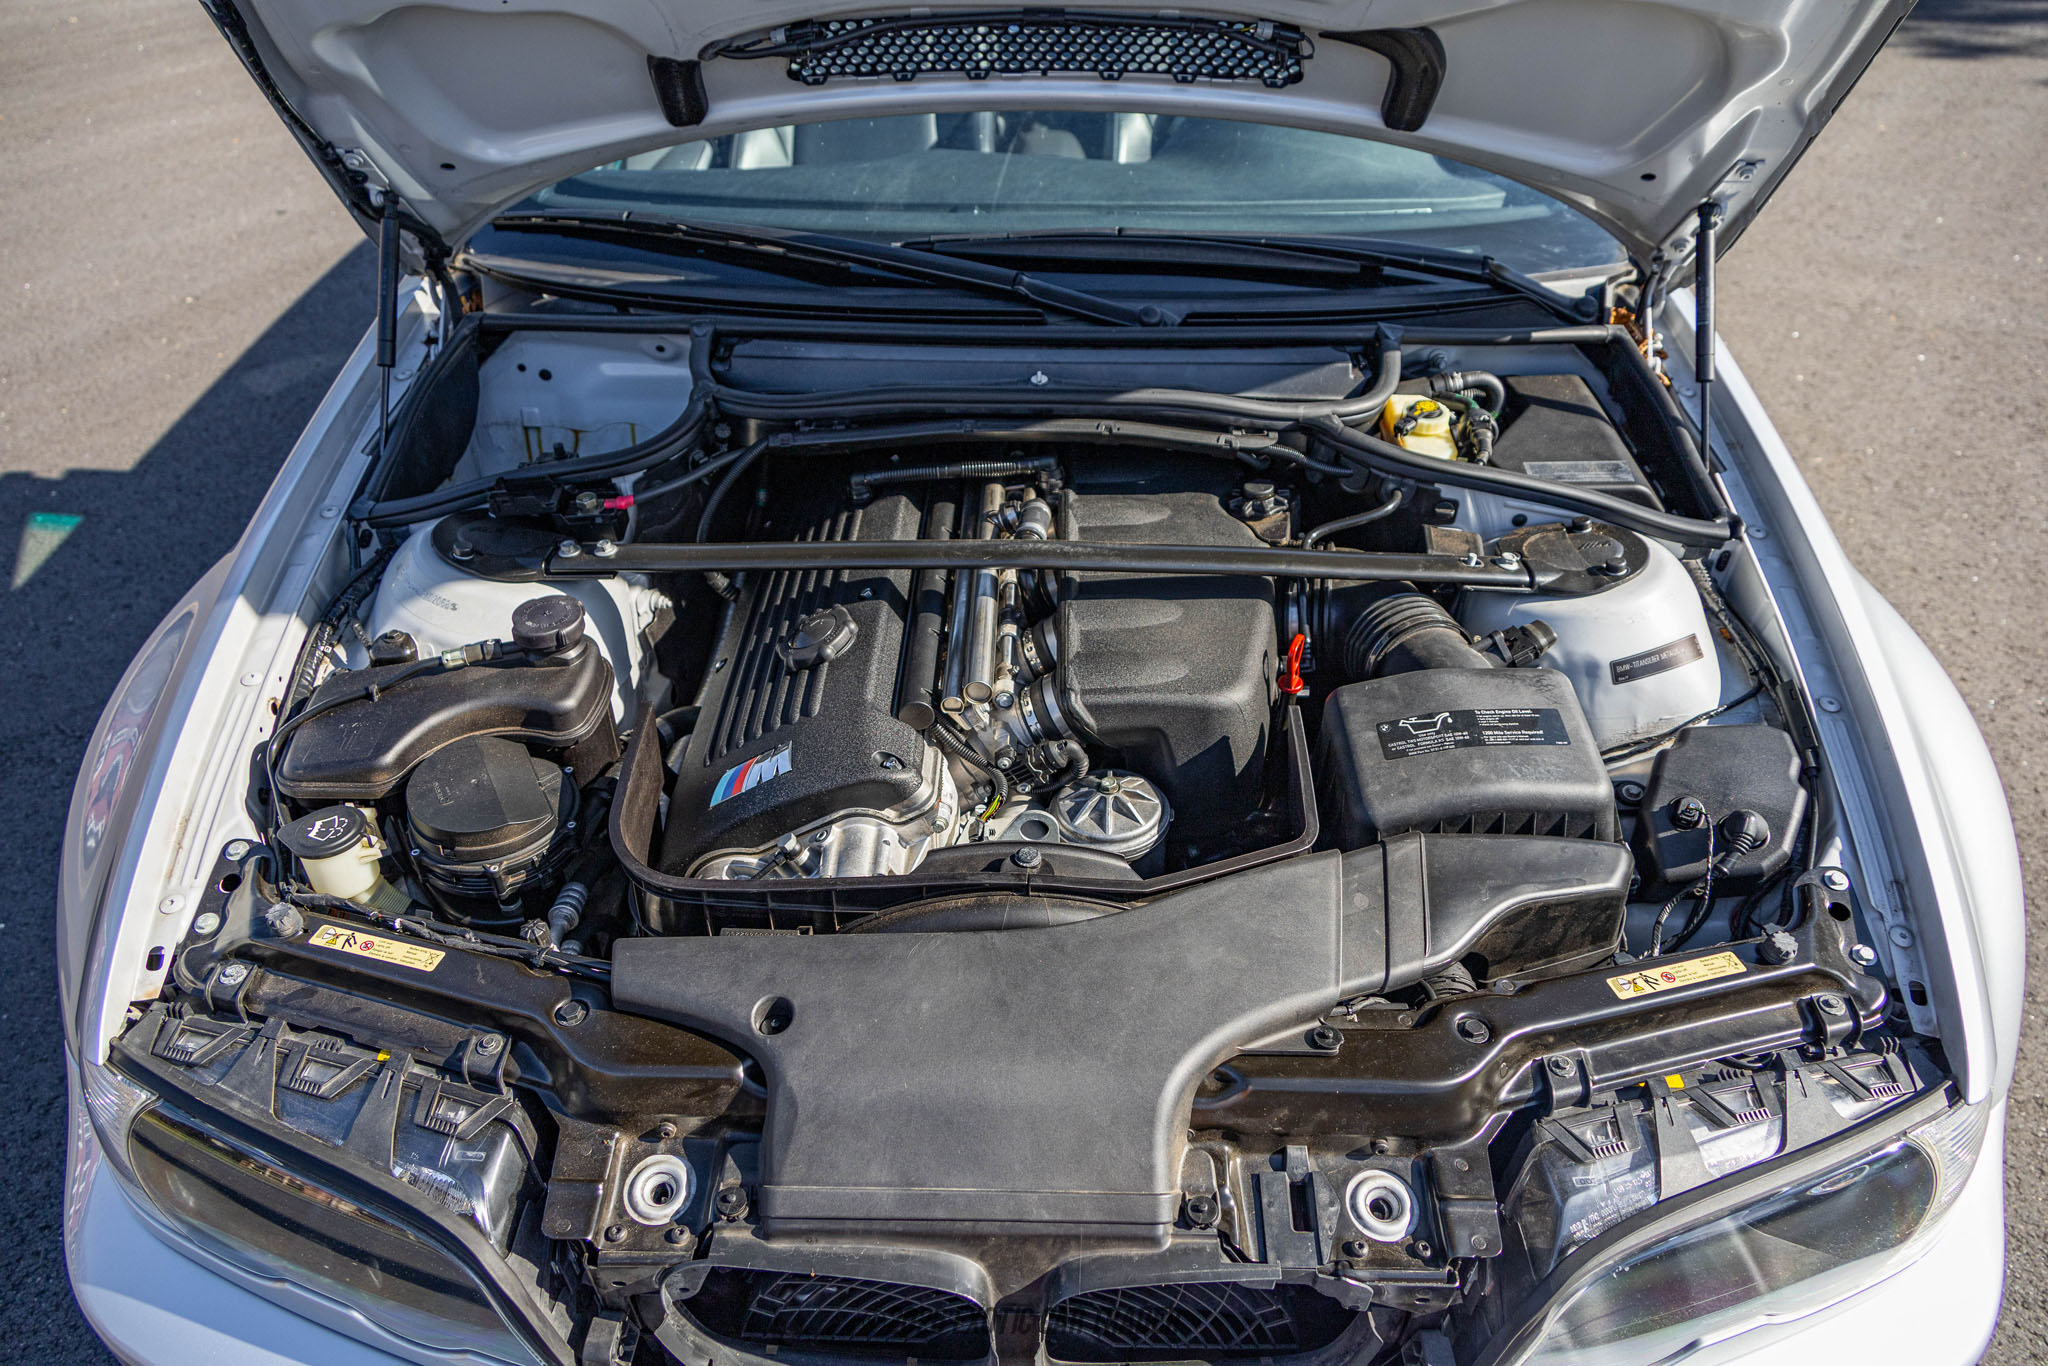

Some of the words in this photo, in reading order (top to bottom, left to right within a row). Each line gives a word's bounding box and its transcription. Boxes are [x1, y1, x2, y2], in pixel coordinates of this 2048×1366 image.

[1388, 740, 1407, 748] CASTROL
[1416, 734, 1444, 742] MOTORSPORT
[1417, 739, 1439, 747] FORMULA
